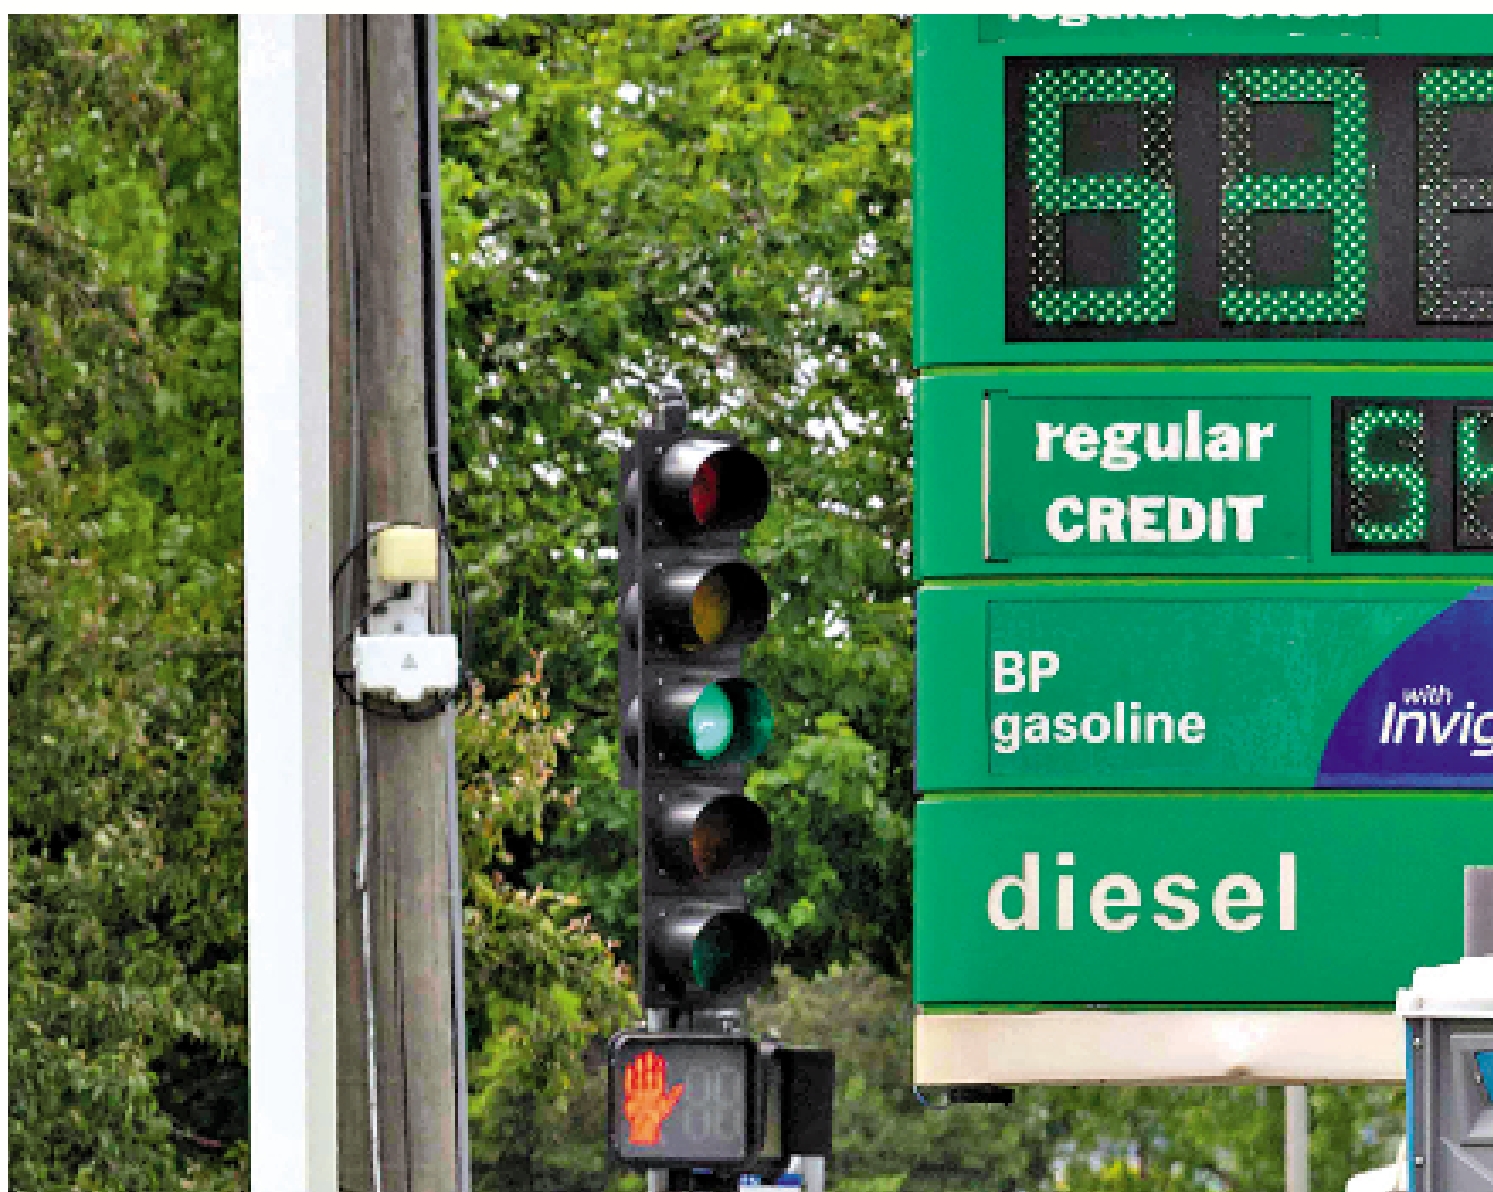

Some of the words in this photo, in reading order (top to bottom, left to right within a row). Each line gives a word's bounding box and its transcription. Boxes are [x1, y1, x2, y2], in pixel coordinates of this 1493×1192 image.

[1035, 410, 1276, 471] regular
[1045, 495, 1267, 542] CREDIT
[991, 650, 1060, 693] BP
[1402, 684, 1454, 706] with
[991, 701, 1207, 754] gasoline
[987, 852, 1298, 932] diesel
